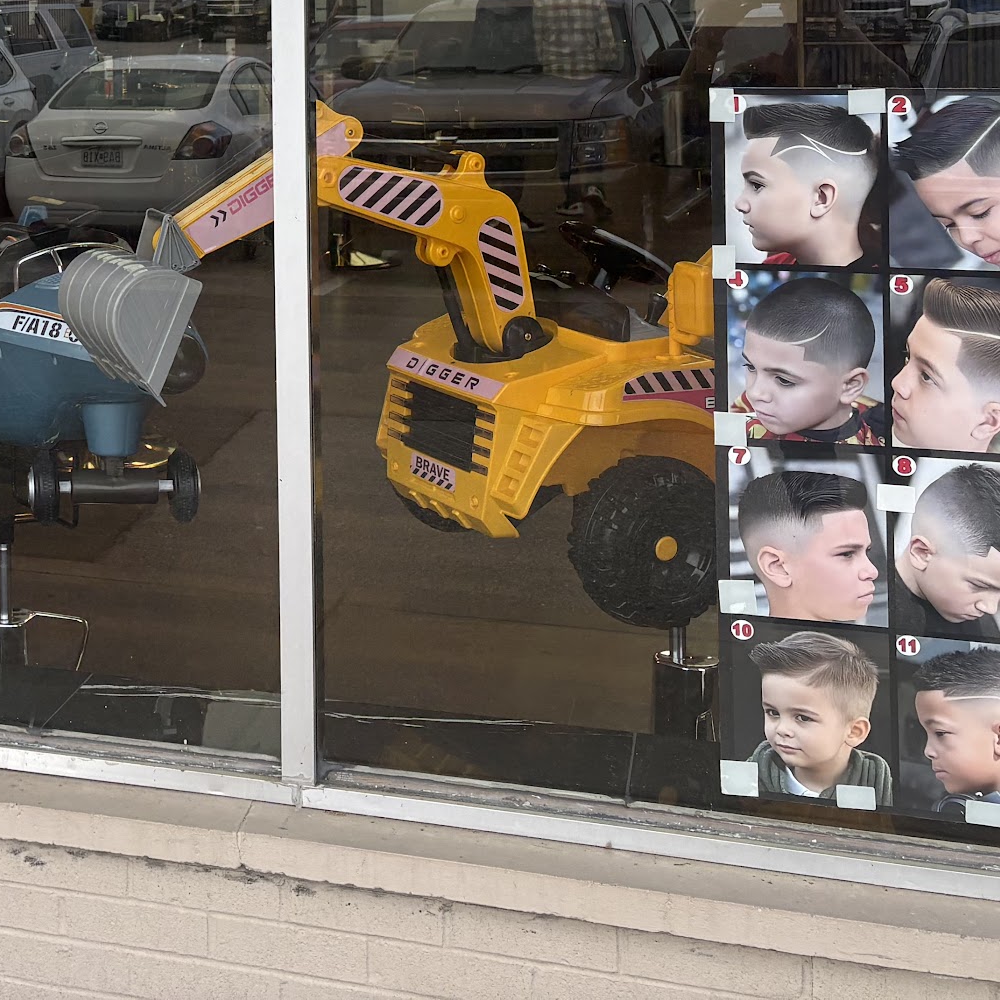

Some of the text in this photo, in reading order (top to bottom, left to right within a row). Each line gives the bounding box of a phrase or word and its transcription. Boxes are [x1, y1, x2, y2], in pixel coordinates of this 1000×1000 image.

[891, 97, 907, 113] 2
[227, 173, 273, 215] DIGGE
[728, 271, 744, 287] 4
[894, 277, 909, 293] 5
[12, 314, 62, 338] F/A18
[405, 357, 480, 390] DIGGER
[732, 448, 747, 464] 7
[415, 455, 450, 482] BRAVE
[897, 457, 912, 474] 8
[732, 623, 751, 638] 10
[898, 637, 917, 654] 11
